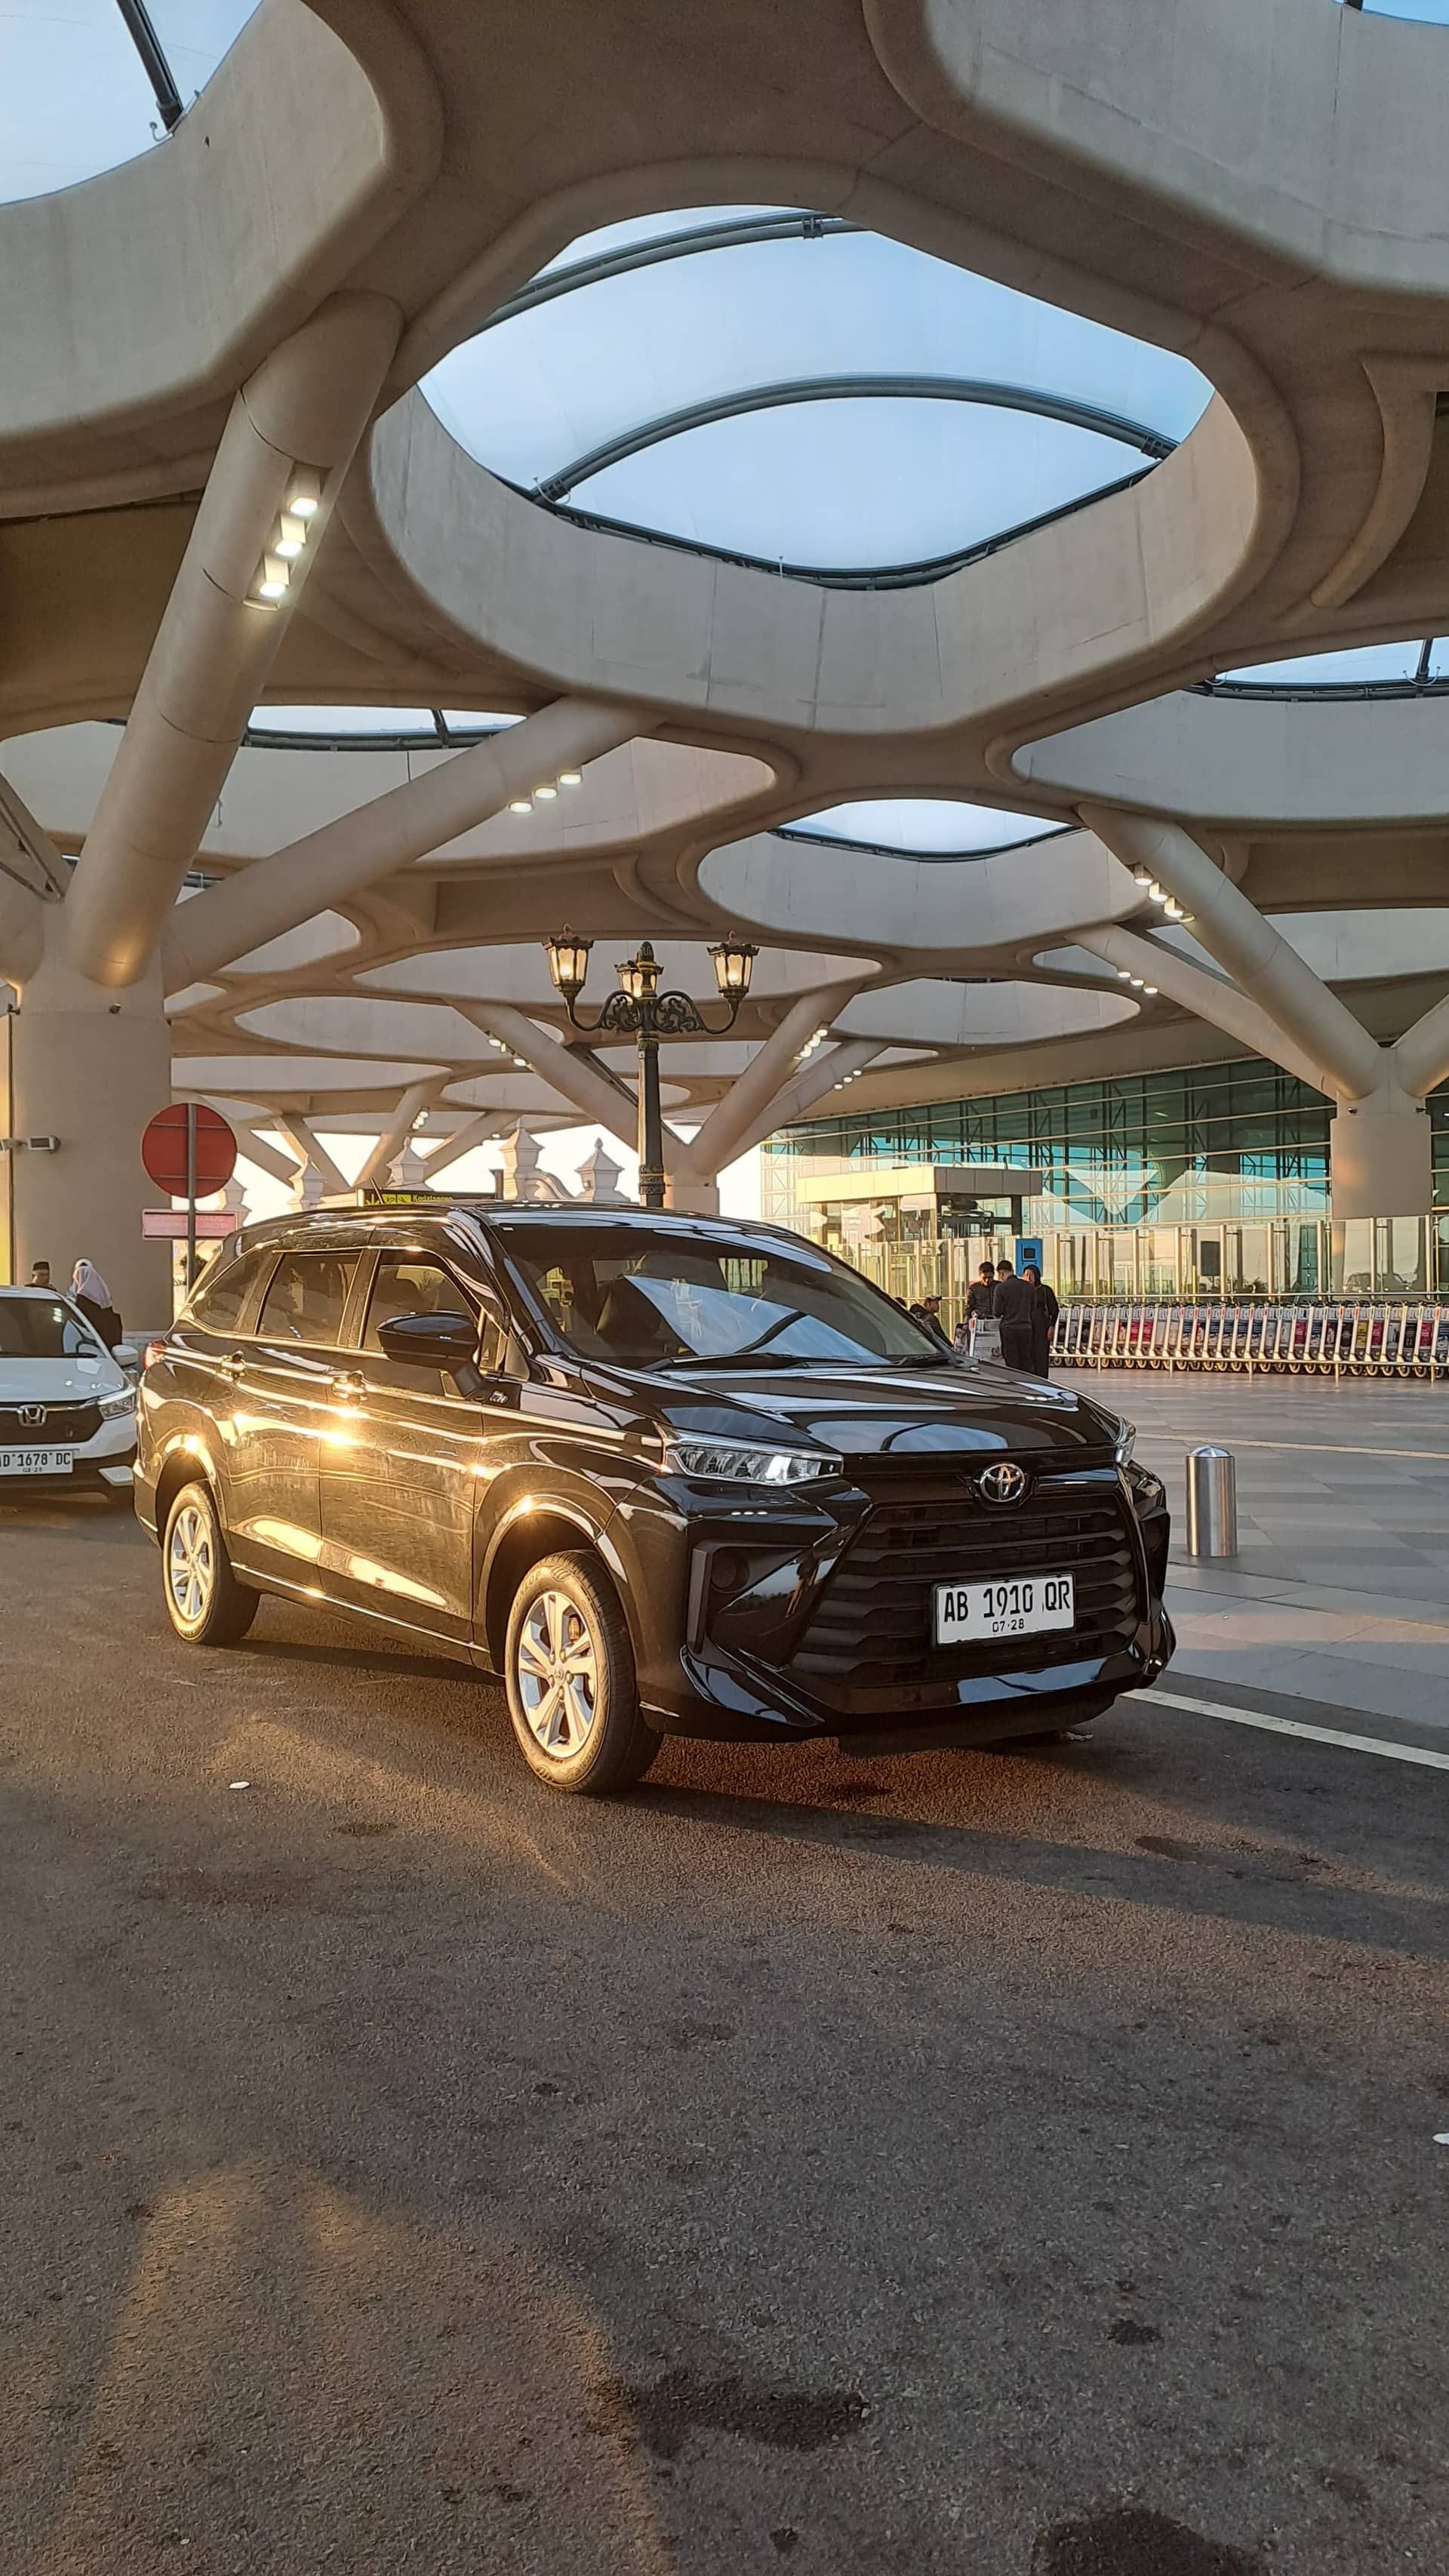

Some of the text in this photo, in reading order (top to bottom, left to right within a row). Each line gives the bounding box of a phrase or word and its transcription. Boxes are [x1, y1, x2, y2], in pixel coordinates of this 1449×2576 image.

[17, 1454, 48, 1467] 1678
[56, 1453, 71, 1465] DC
[944, 1581, 1070, 1622] AB 1910 QR
